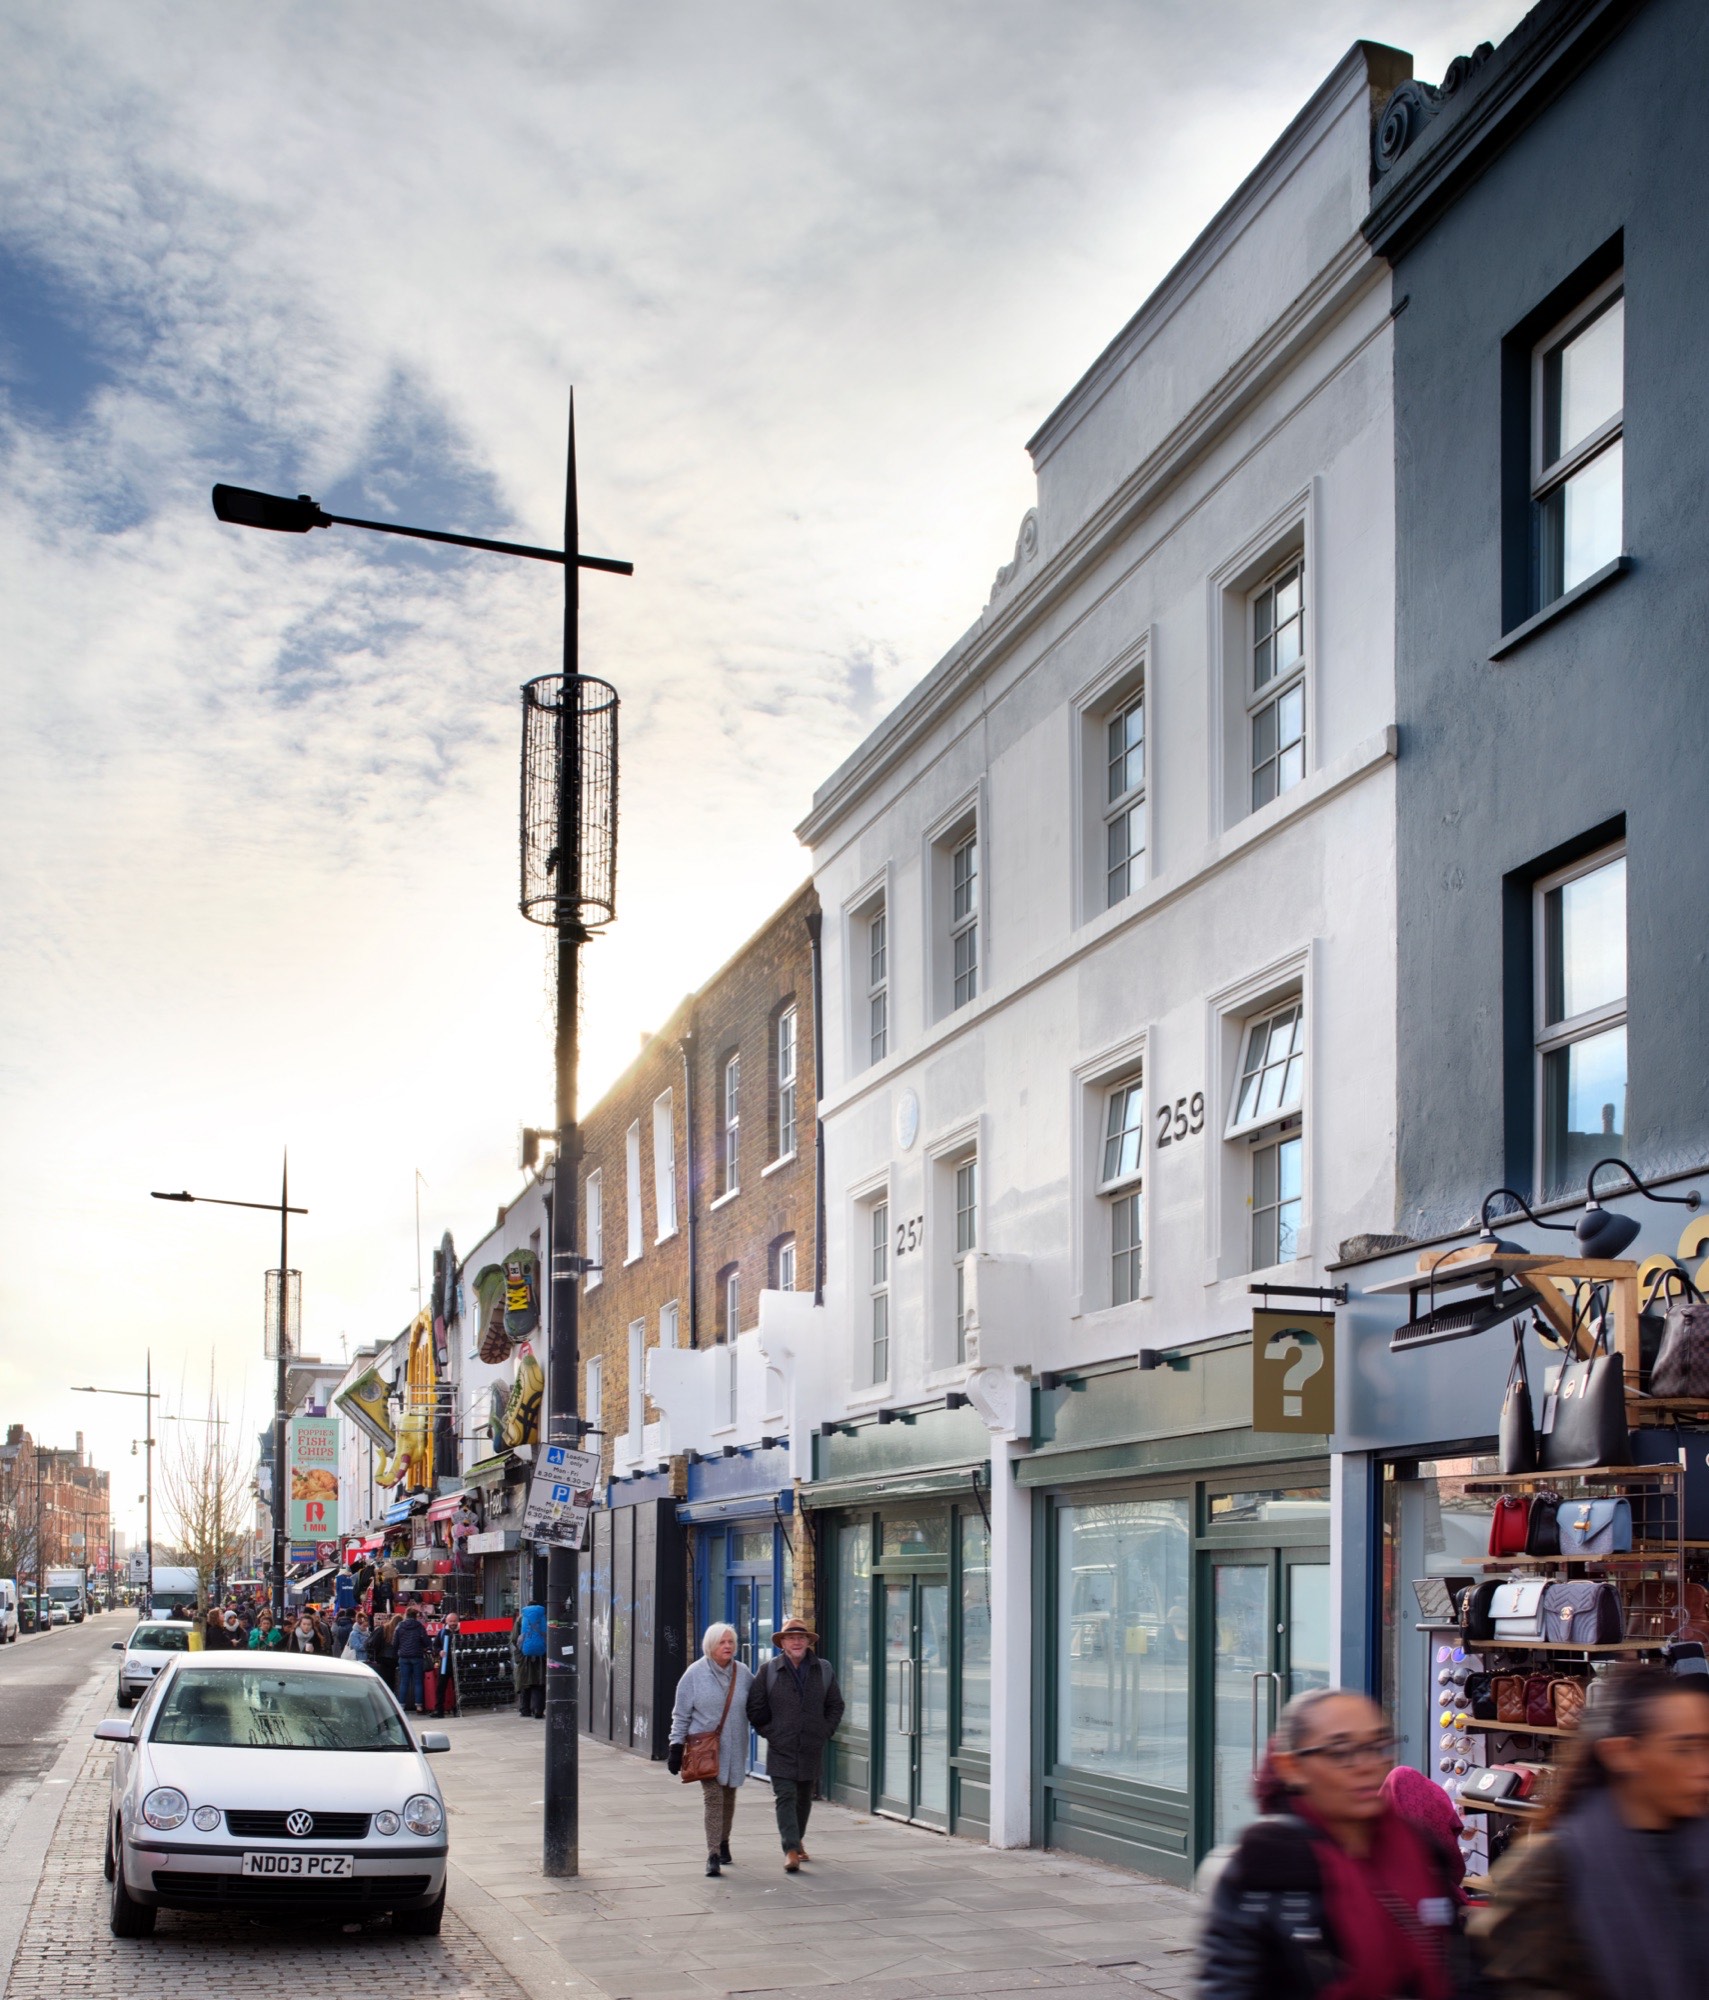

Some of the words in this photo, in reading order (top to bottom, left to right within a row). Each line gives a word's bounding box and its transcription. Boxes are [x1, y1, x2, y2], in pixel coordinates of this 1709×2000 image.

[1156, 1091, 1204, 1148] 259
[896, 1215, 923, 1256] 257
[297, 1435, 327, 1446] FISH
[297, 1446, 334, 1457] CHIPS
[566, 1453, 590, 1464] Loading
[537, 1470, 552, 1478] 8.30
[566, 1477, 581, 1485] 6.30
[527, 1511, 542, 1519] 6.30
[528, 1505, 555, 1514] Midnigh
[303, 1523, 307, 1532] 1
[309, 1523, 327, 1532] MIN
[250, 1855, 302, 1874] ND03
[308, 1857, 345, 1875] PCZ
